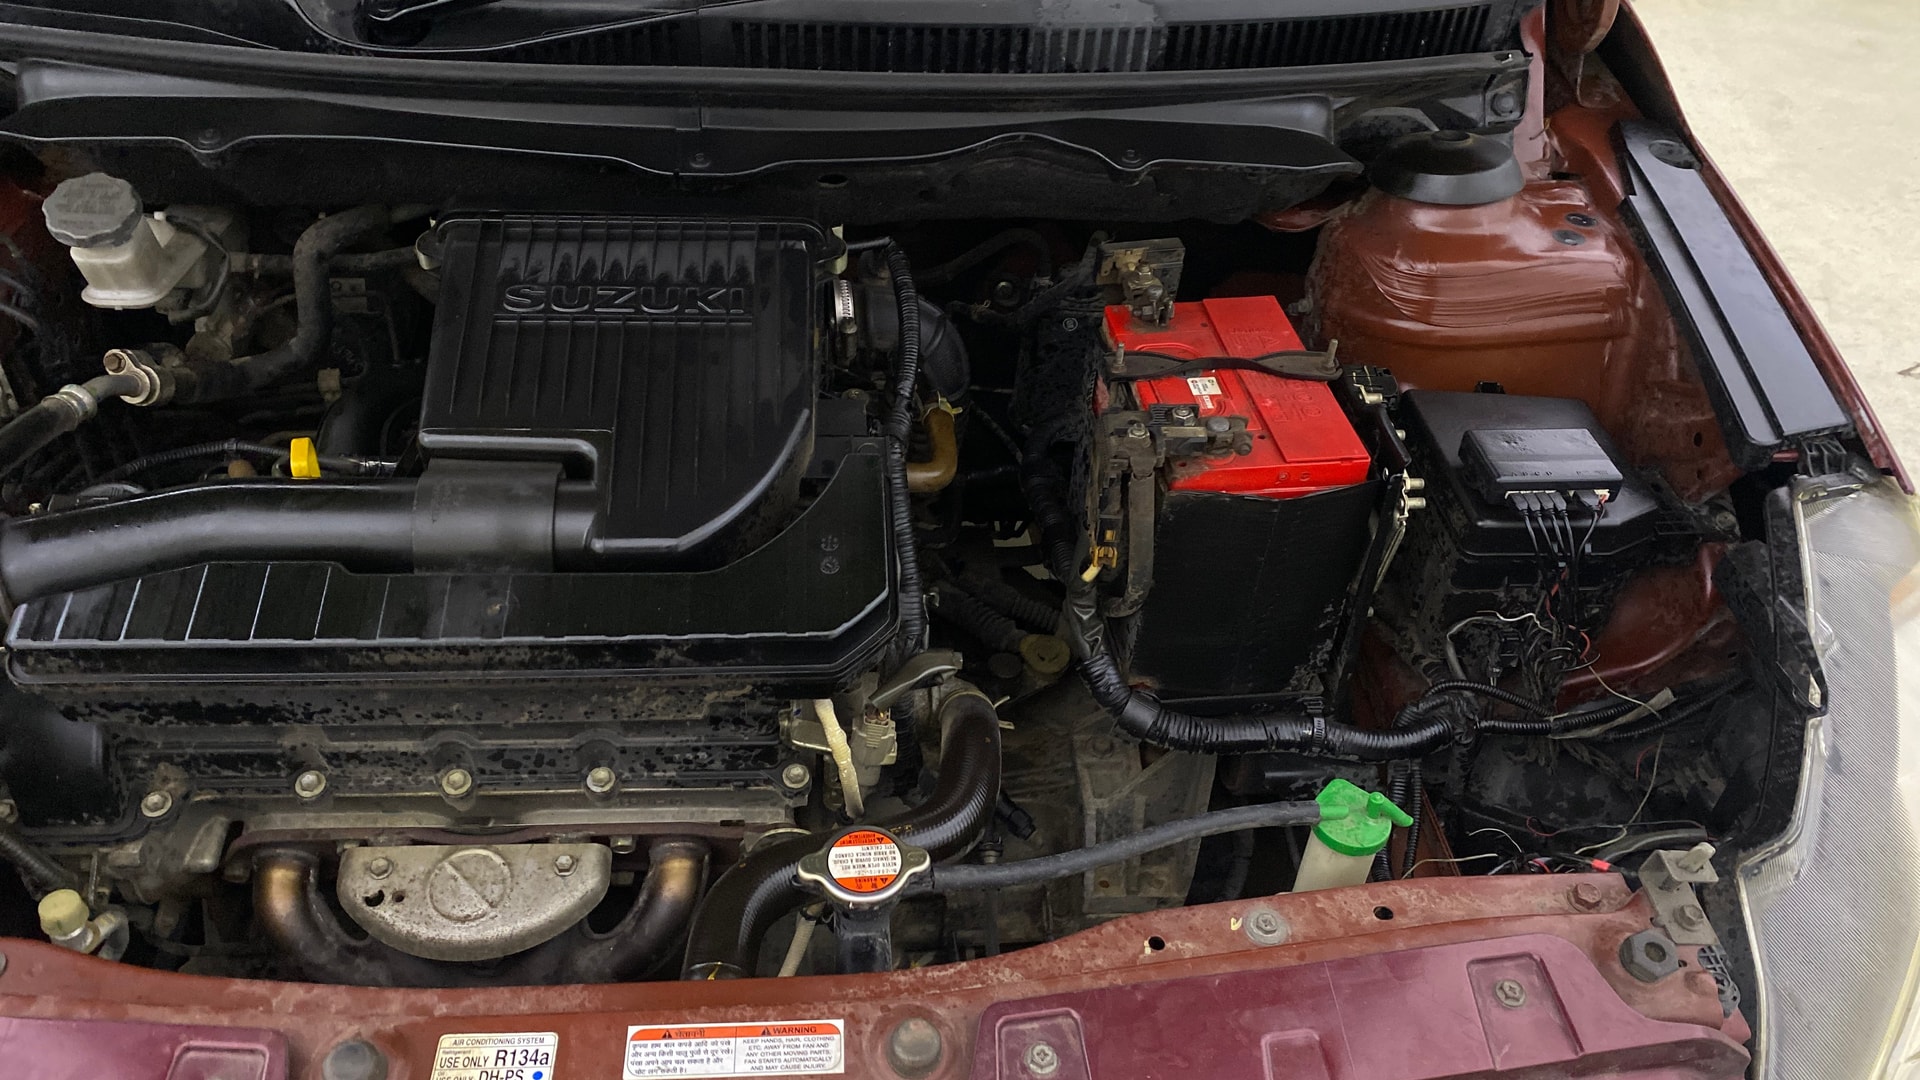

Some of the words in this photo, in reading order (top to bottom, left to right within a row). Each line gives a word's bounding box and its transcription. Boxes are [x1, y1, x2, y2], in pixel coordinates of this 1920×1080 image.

[503, 284, 745, 313] SUZUKI
[466, 1038, 516, 1046] CONDITIONING
[440, 1057, 460, 1068] USE
[462, 1056, 490, 1068] ONLY
[494, 1048, 550, 1067] R134a
